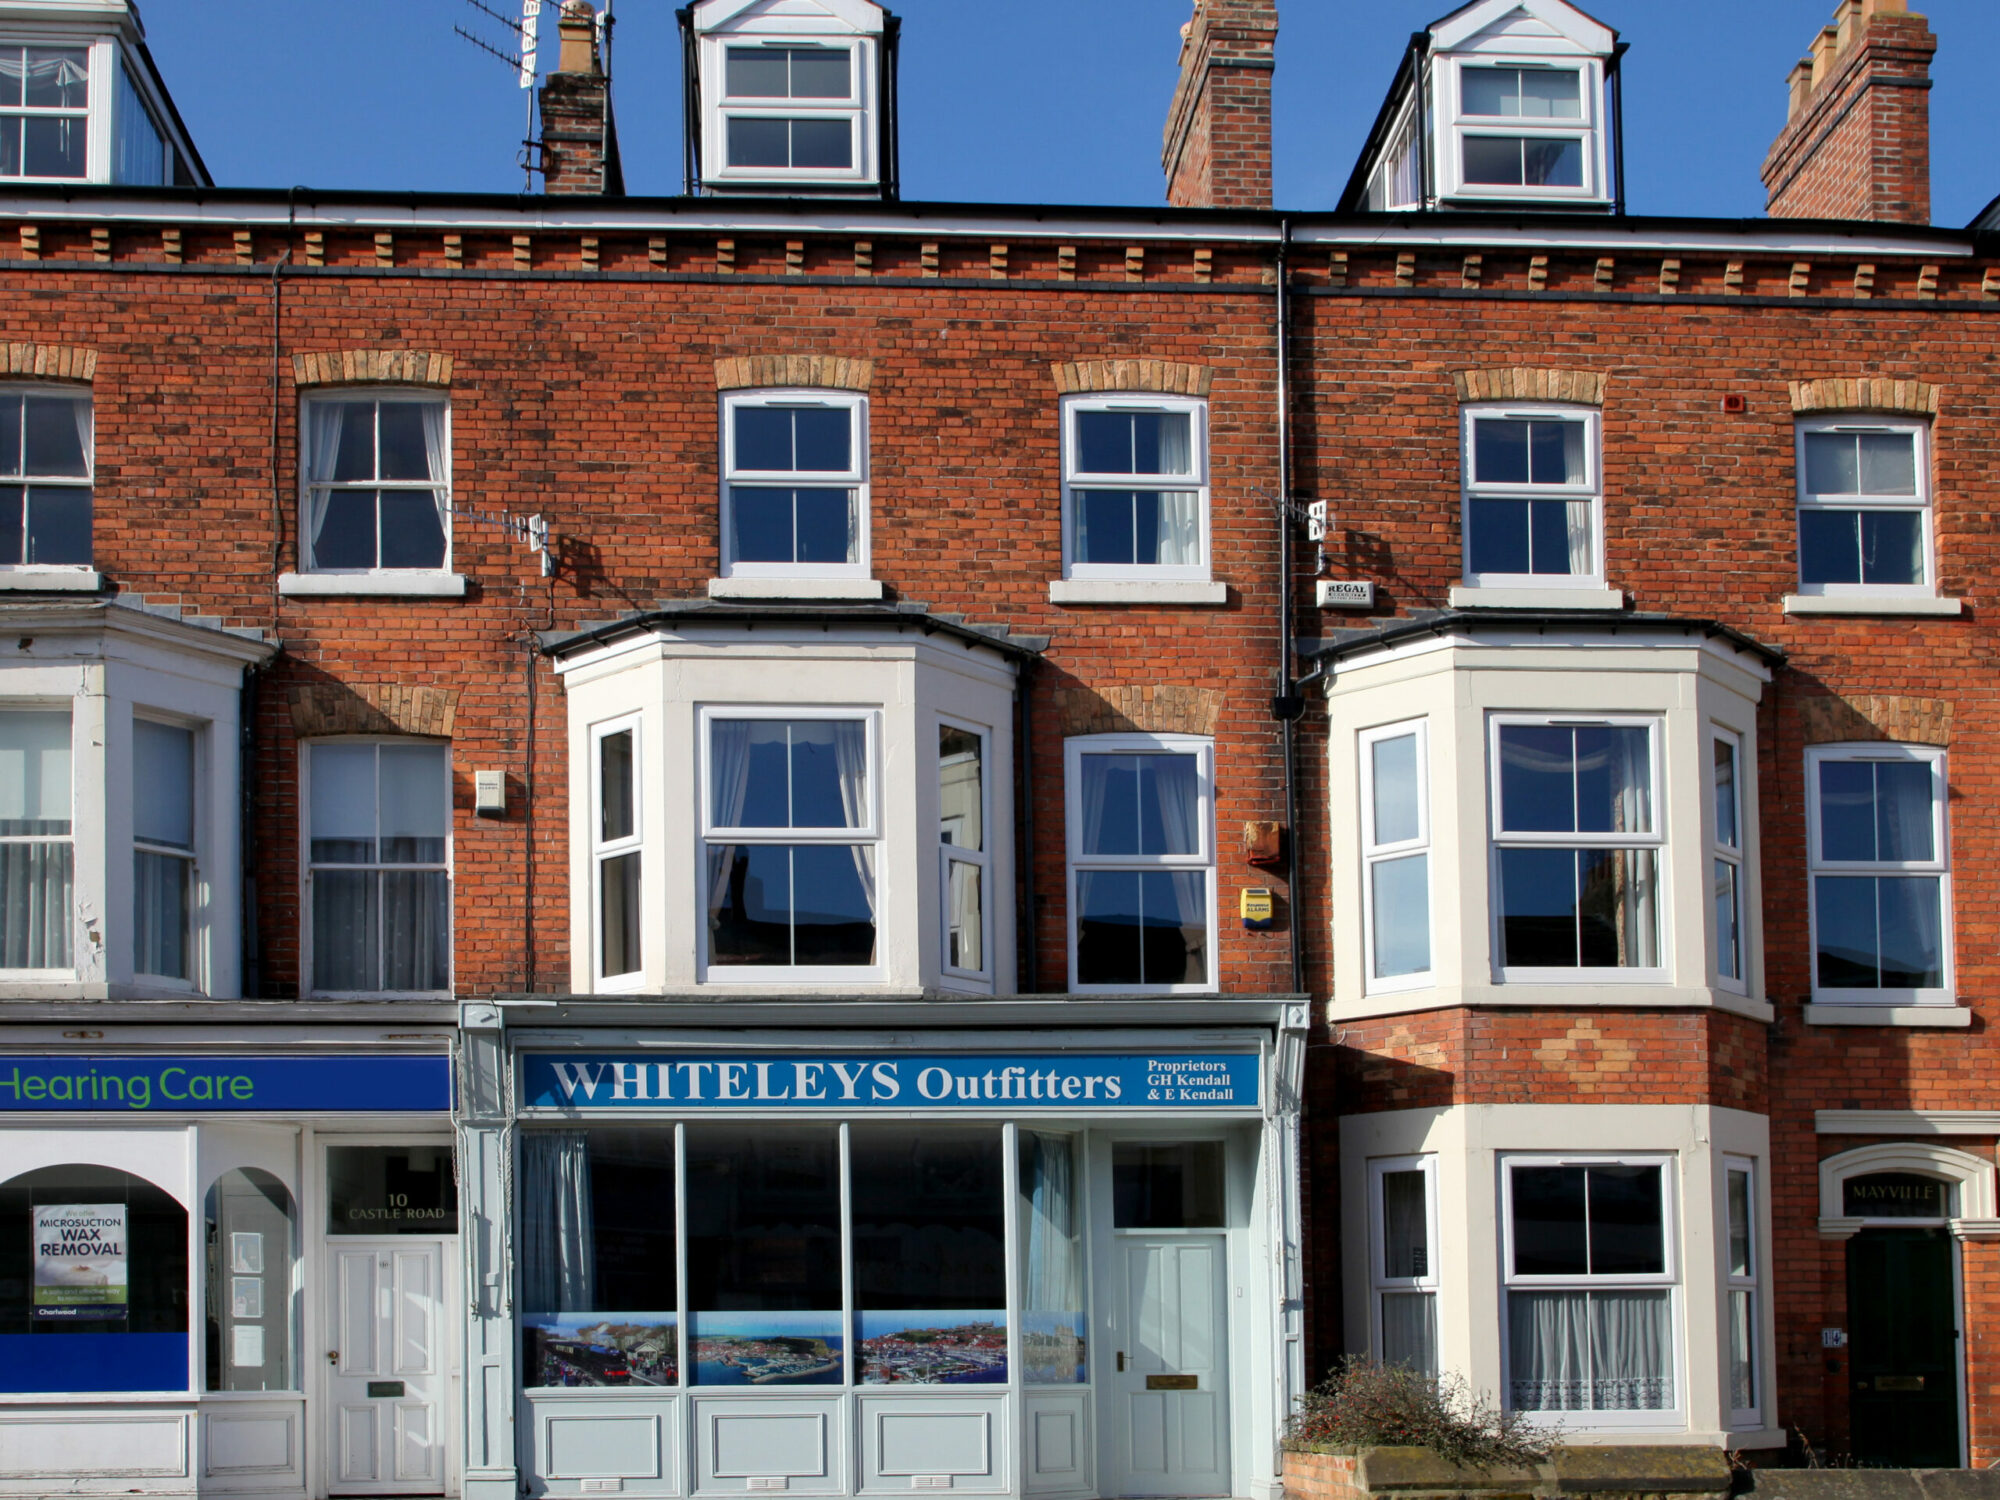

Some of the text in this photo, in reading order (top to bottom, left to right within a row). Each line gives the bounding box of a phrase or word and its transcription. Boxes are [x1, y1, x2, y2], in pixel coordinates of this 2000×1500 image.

[1328, 584, 1366, 592] REGAL
[1147, 1060, 1227, 1074] Proprietors
[159, 1067, 254, 1100] Care
[550, 1061, 1122, 1100] WHITELEYS Outfitters
[1147, 1074, 1231, 1086] GH Kendall
[1147, 1088, 1233, 1100] & E Kendall
[1853, 1185, 1933, 1199] MAYVILLE
[388, 1193, 408, 1207] 10
[349, 1208, 445, 1219] CASTLE ROAD
[40, 1218, 121, 1228] MICROSUCTION
[61, 1229, 101, 1241] WAX
[40, 1242, 122, 1256] REMOVAL
[38, 1308, 77, 1316] Charlwood
[1824, 1331, 1840, 1345] 14
